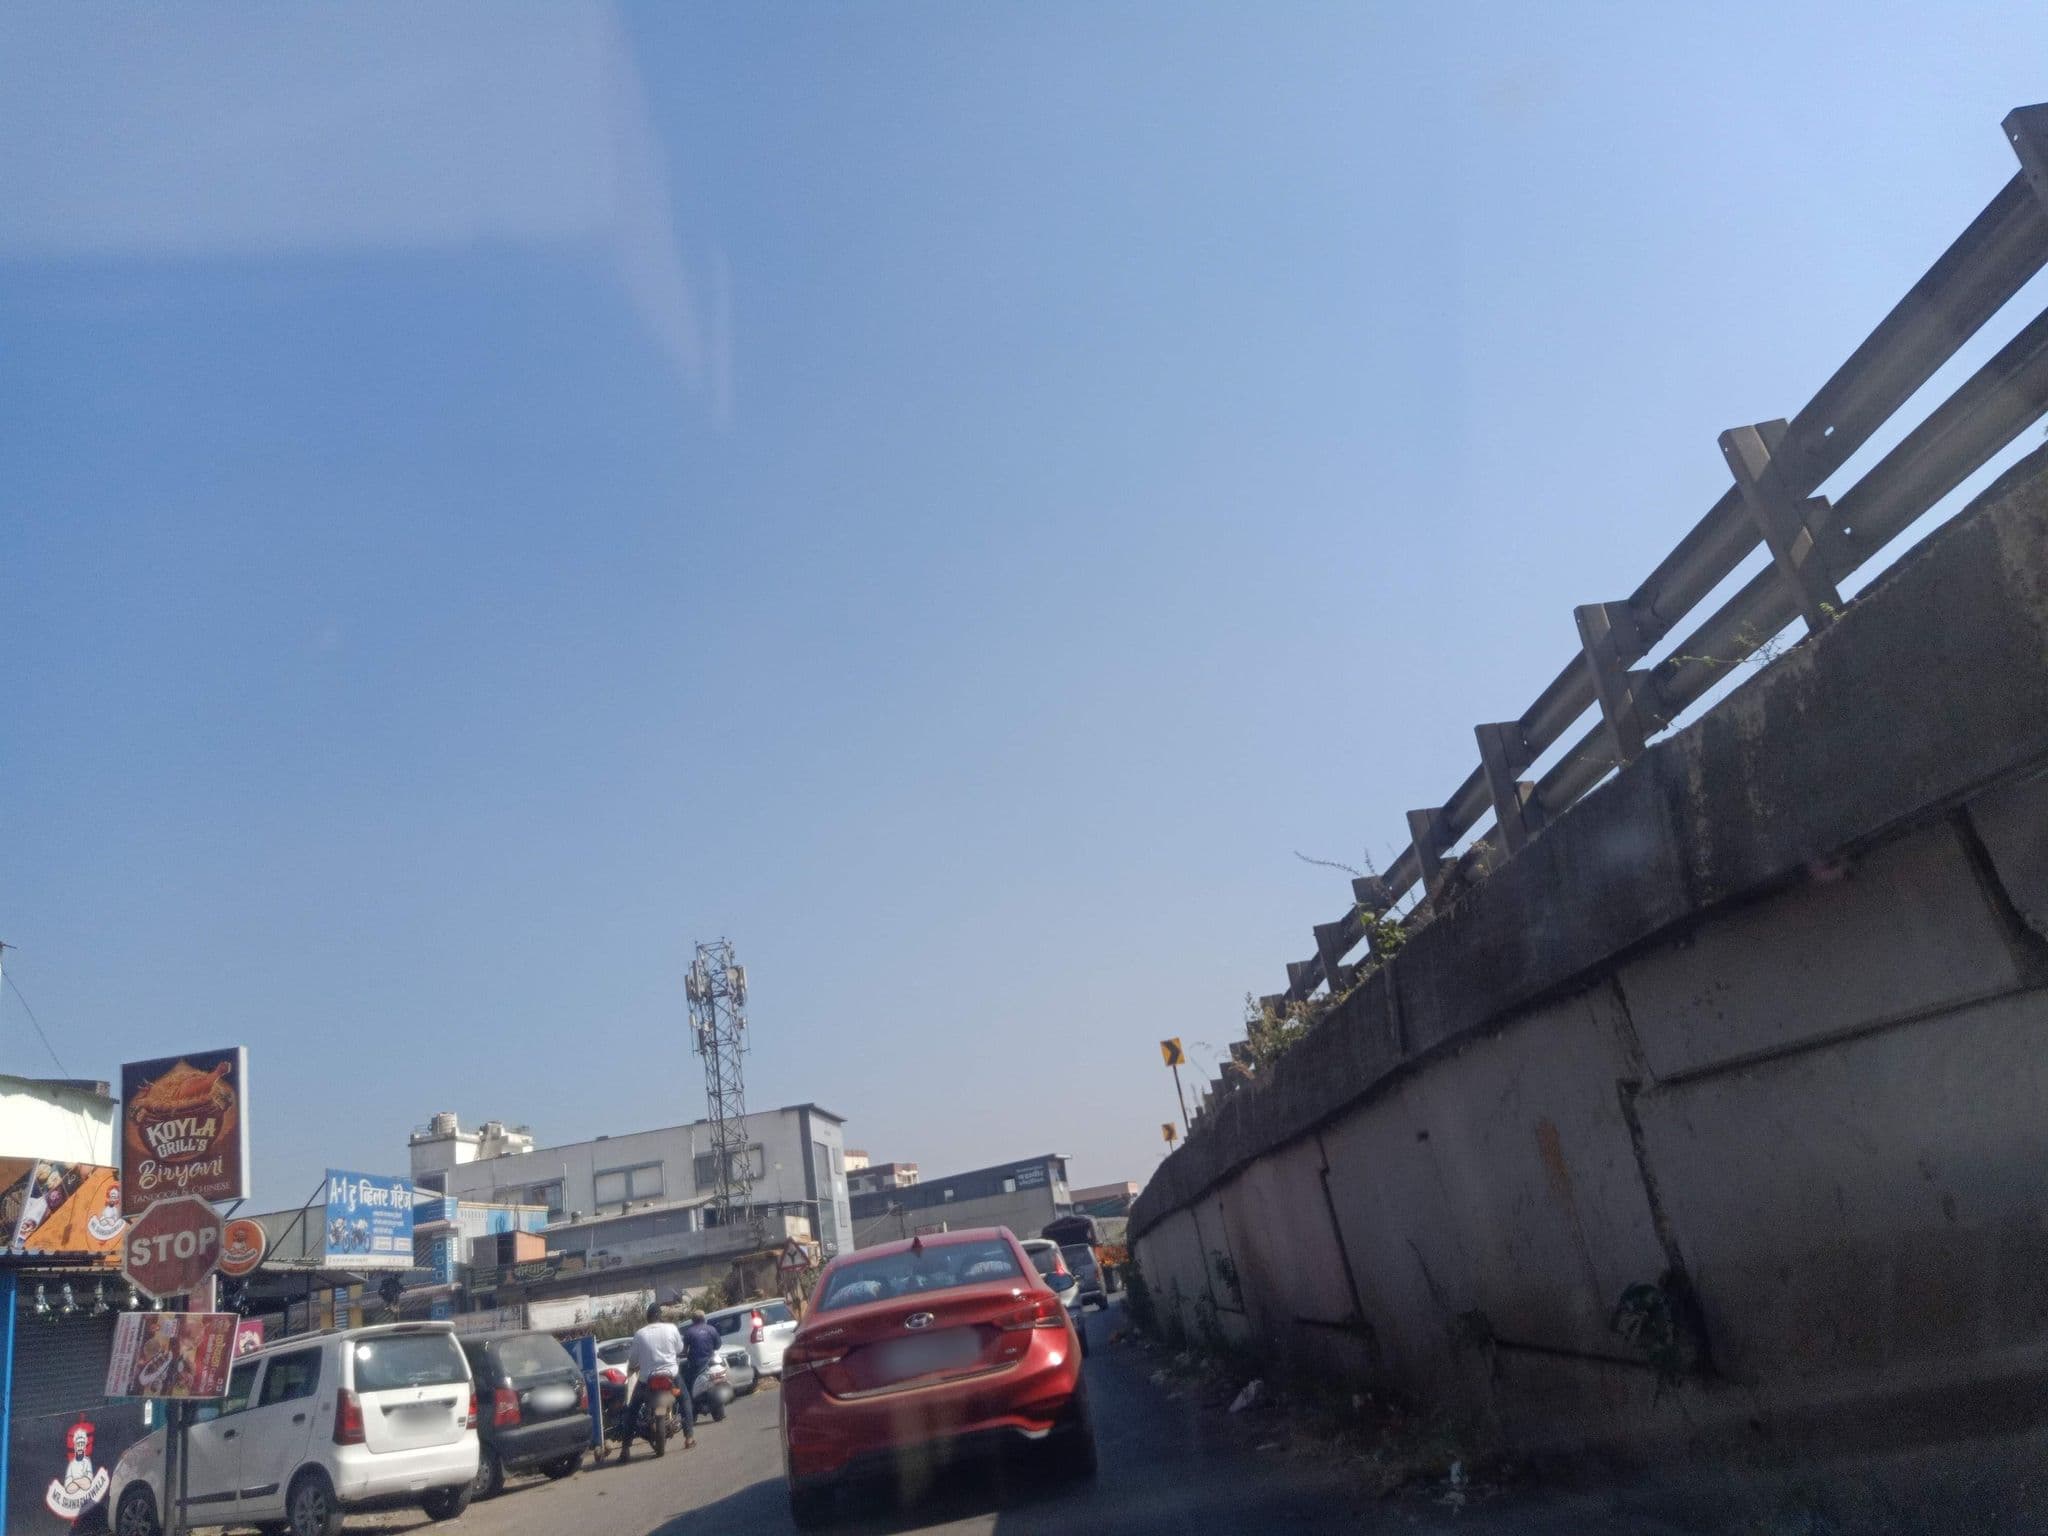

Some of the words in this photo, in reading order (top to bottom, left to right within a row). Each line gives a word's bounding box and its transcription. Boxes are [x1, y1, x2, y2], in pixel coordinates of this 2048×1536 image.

[146, 1118, 217, 1147] KOYLA
[157, 1139, 208, 1158] GRILL'S
[139, 1156, 223, 1190] Biryani
[131, 1227, 216, 1266] STOP
